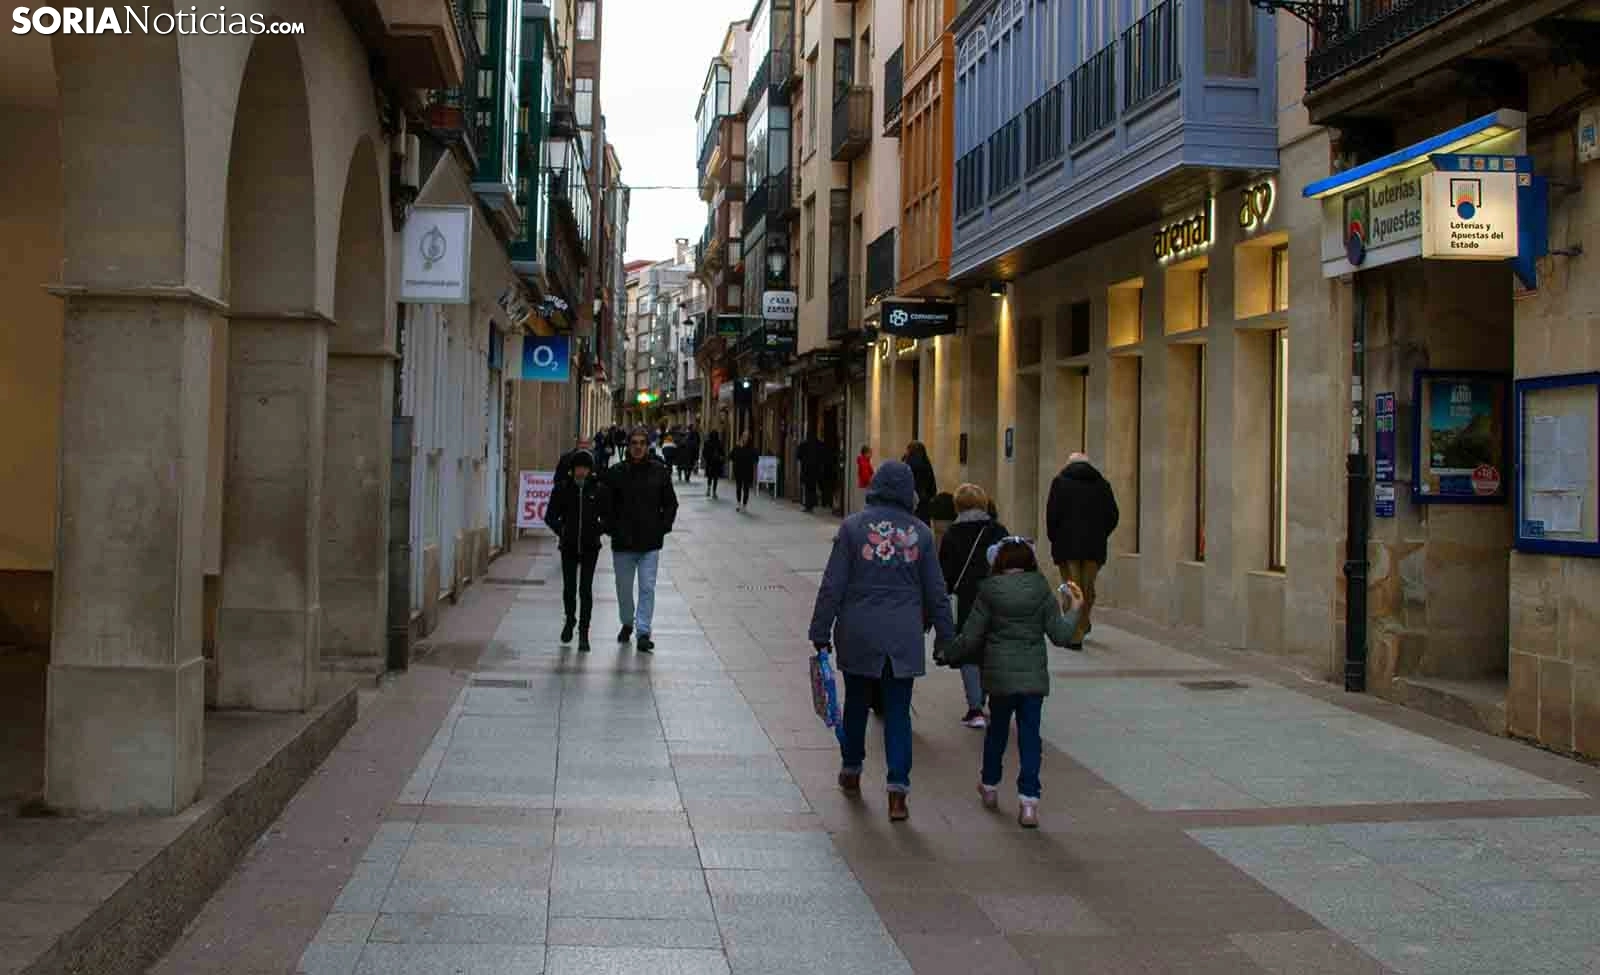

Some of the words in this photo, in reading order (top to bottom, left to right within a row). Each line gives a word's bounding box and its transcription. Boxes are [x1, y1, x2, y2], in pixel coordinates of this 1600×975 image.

[1153, 191, 1213, 259] arenal
[1373, 209, 1421, 241] Apuestas
[1486, 223, 1491, 231] y
[1451, 231, 1489, 240] Apuestas
[1491, 231, 1504, 239] del
[769, 297, 790, 305] CASA
